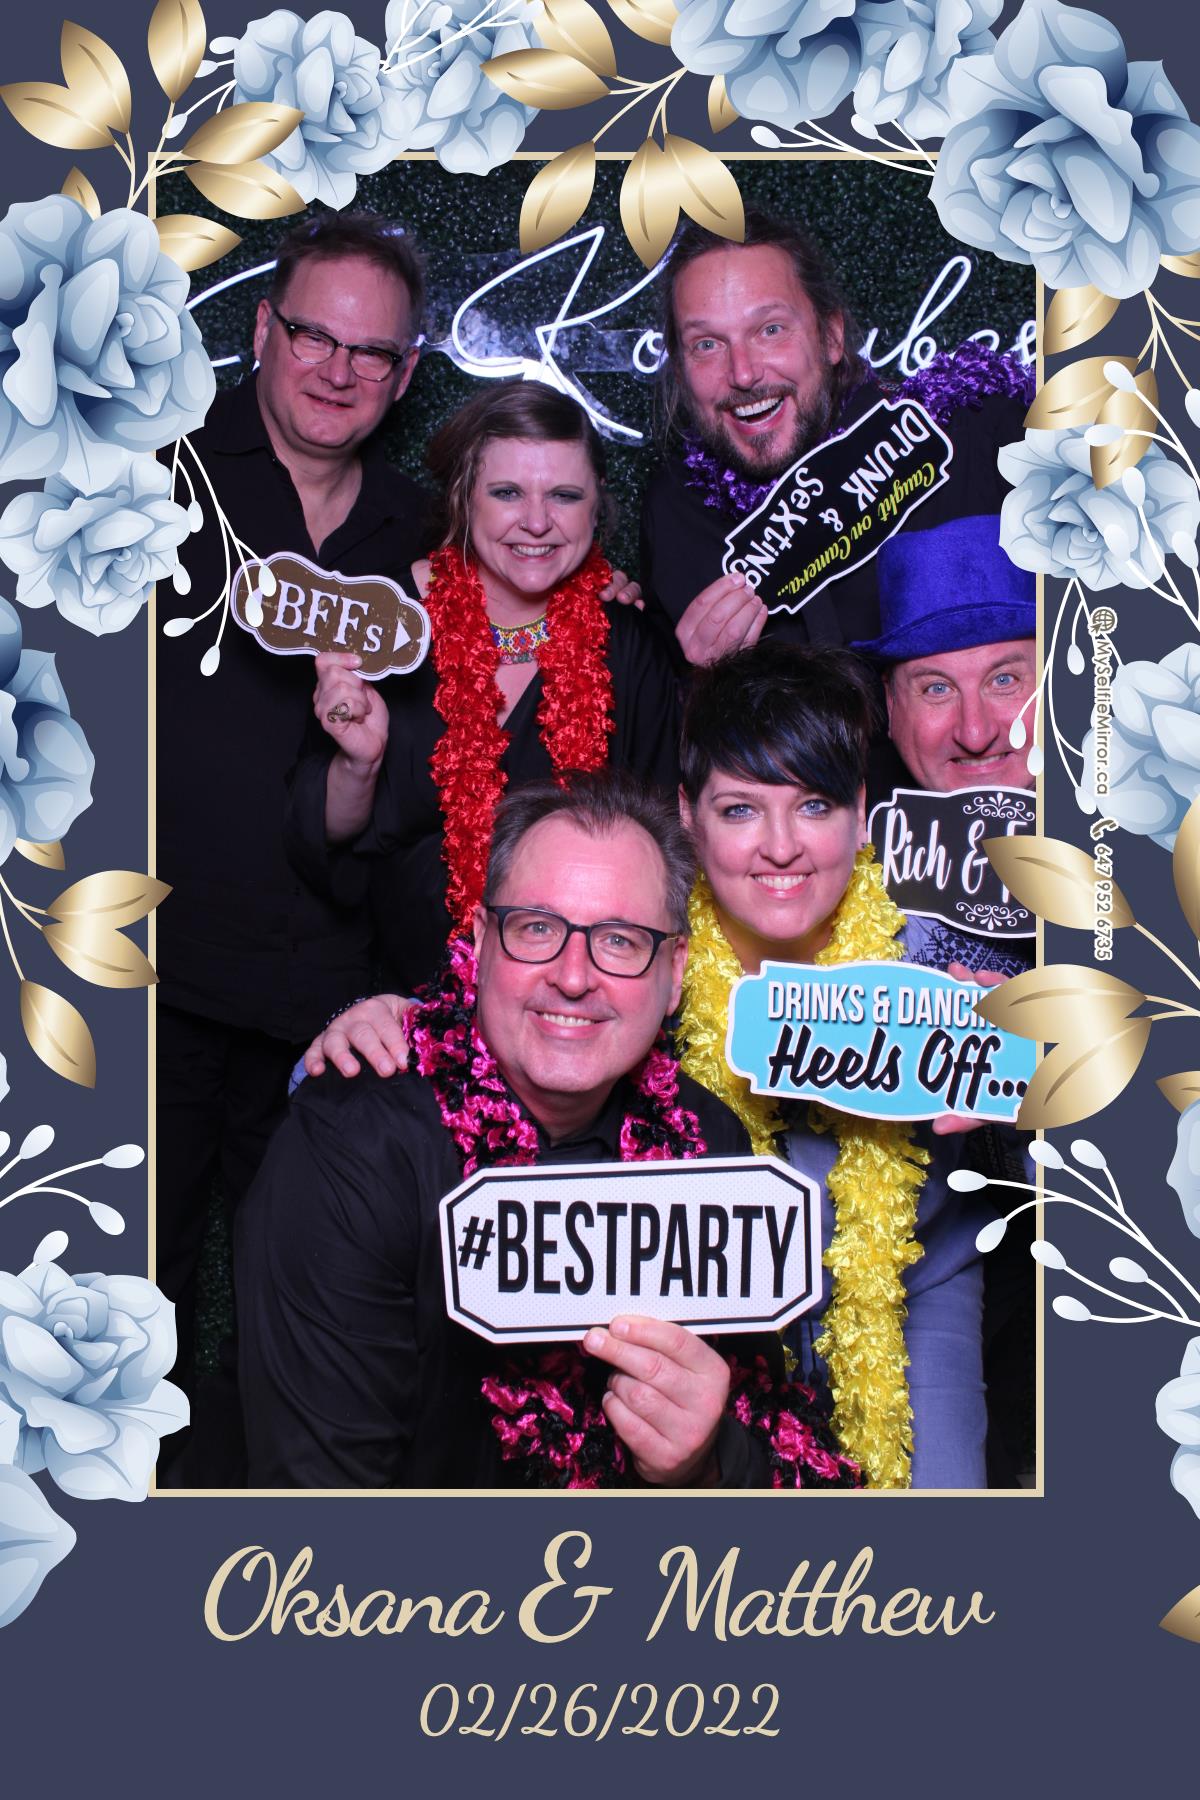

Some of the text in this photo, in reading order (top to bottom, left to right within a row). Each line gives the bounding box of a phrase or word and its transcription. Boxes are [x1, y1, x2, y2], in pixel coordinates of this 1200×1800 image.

[818, 508, 844, 533] &
[877, 462, 935, 523] Caught
[851, 515, 872, 541] on
[271, 579, 383, 653] BFFs
[882, 808, 952, 890] Rich
[961, 819, 989, 895] &
[768, 981, 865, 1024] DRINKS
[872, 985, 891, 1025] &
[768, 1023, 902, 1093] Heels
[457, 1198, 799, 1299] #BESTPARTY
